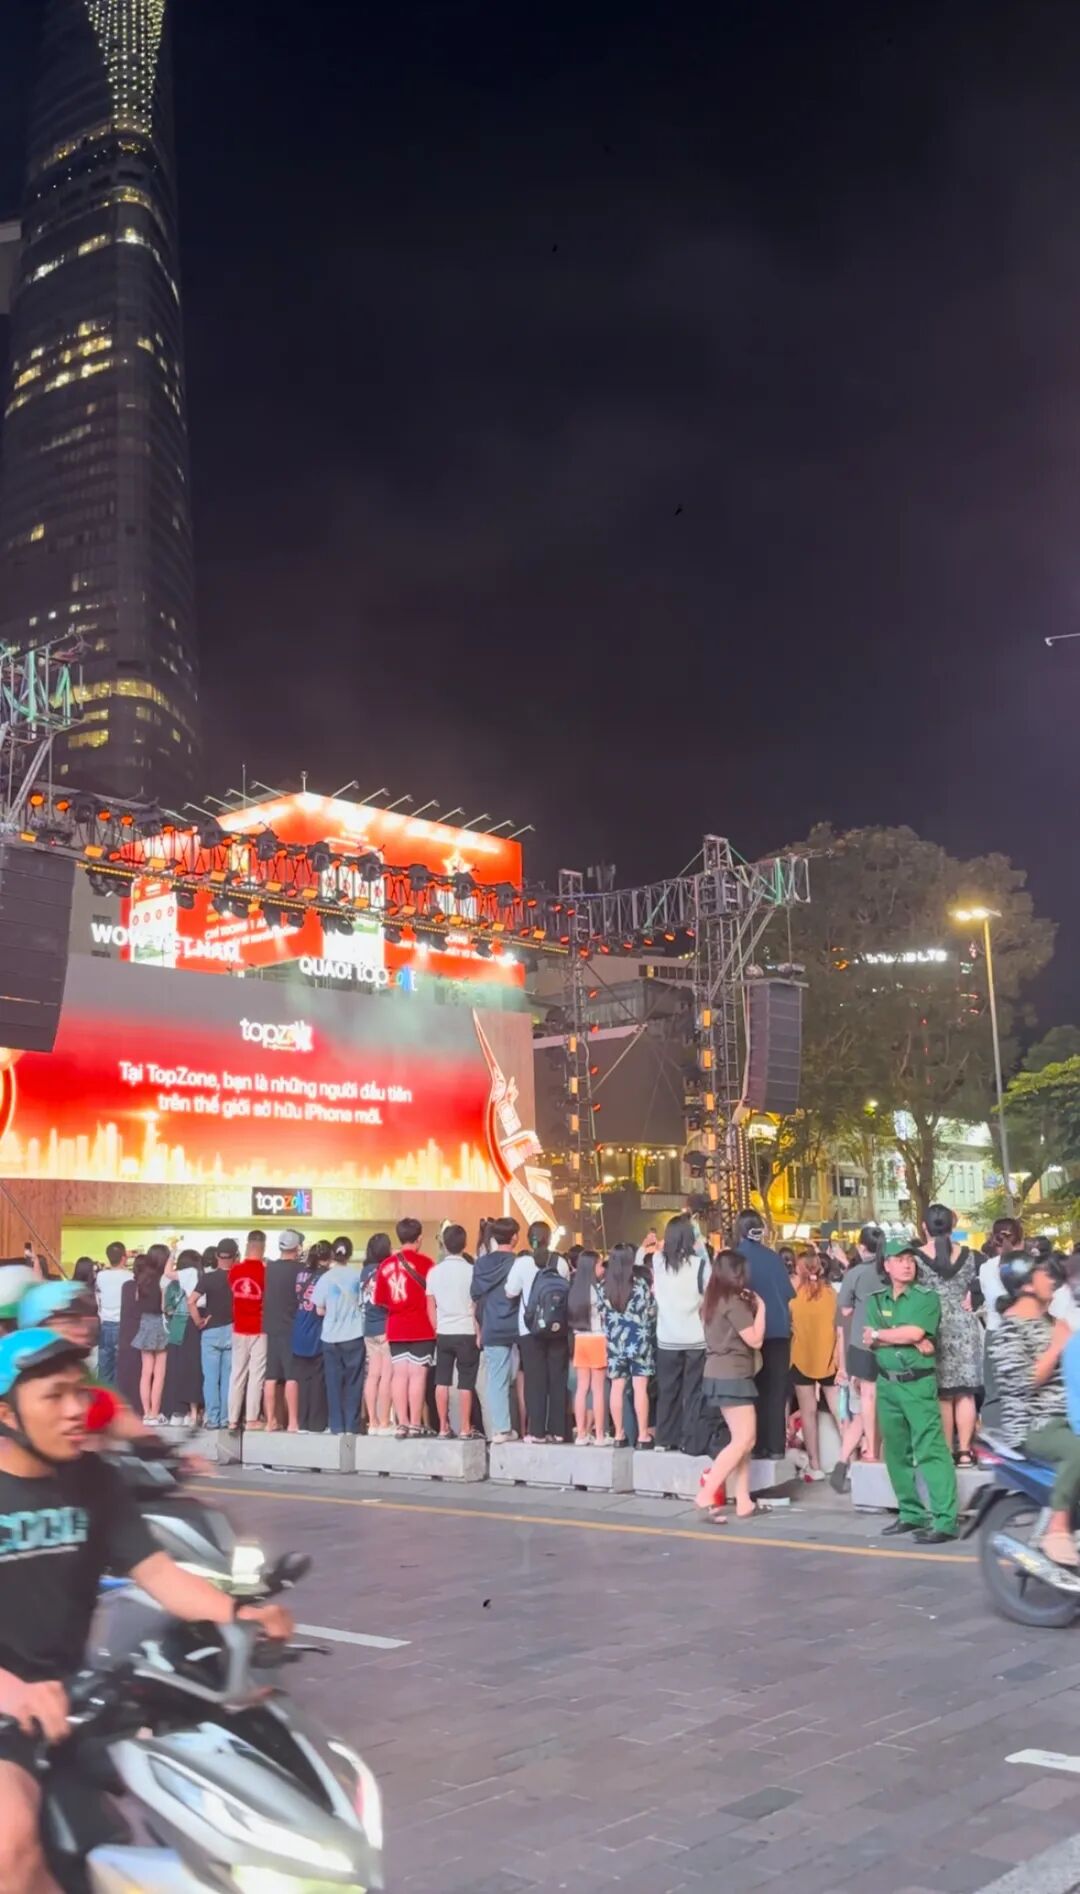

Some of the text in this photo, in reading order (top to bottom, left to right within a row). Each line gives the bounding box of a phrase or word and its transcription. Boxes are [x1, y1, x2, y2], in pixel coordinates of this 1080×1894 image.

[118, 1060, 143, 1086] Tại
[146, 1063, 221, 1091] TopZone,
[222, 1071, 252, 1093] bạn
[254, 1073, 268, 1092] là
[158, 1093, 190, 1112] trên
[304, 1102, 352, 1123] iPhone
